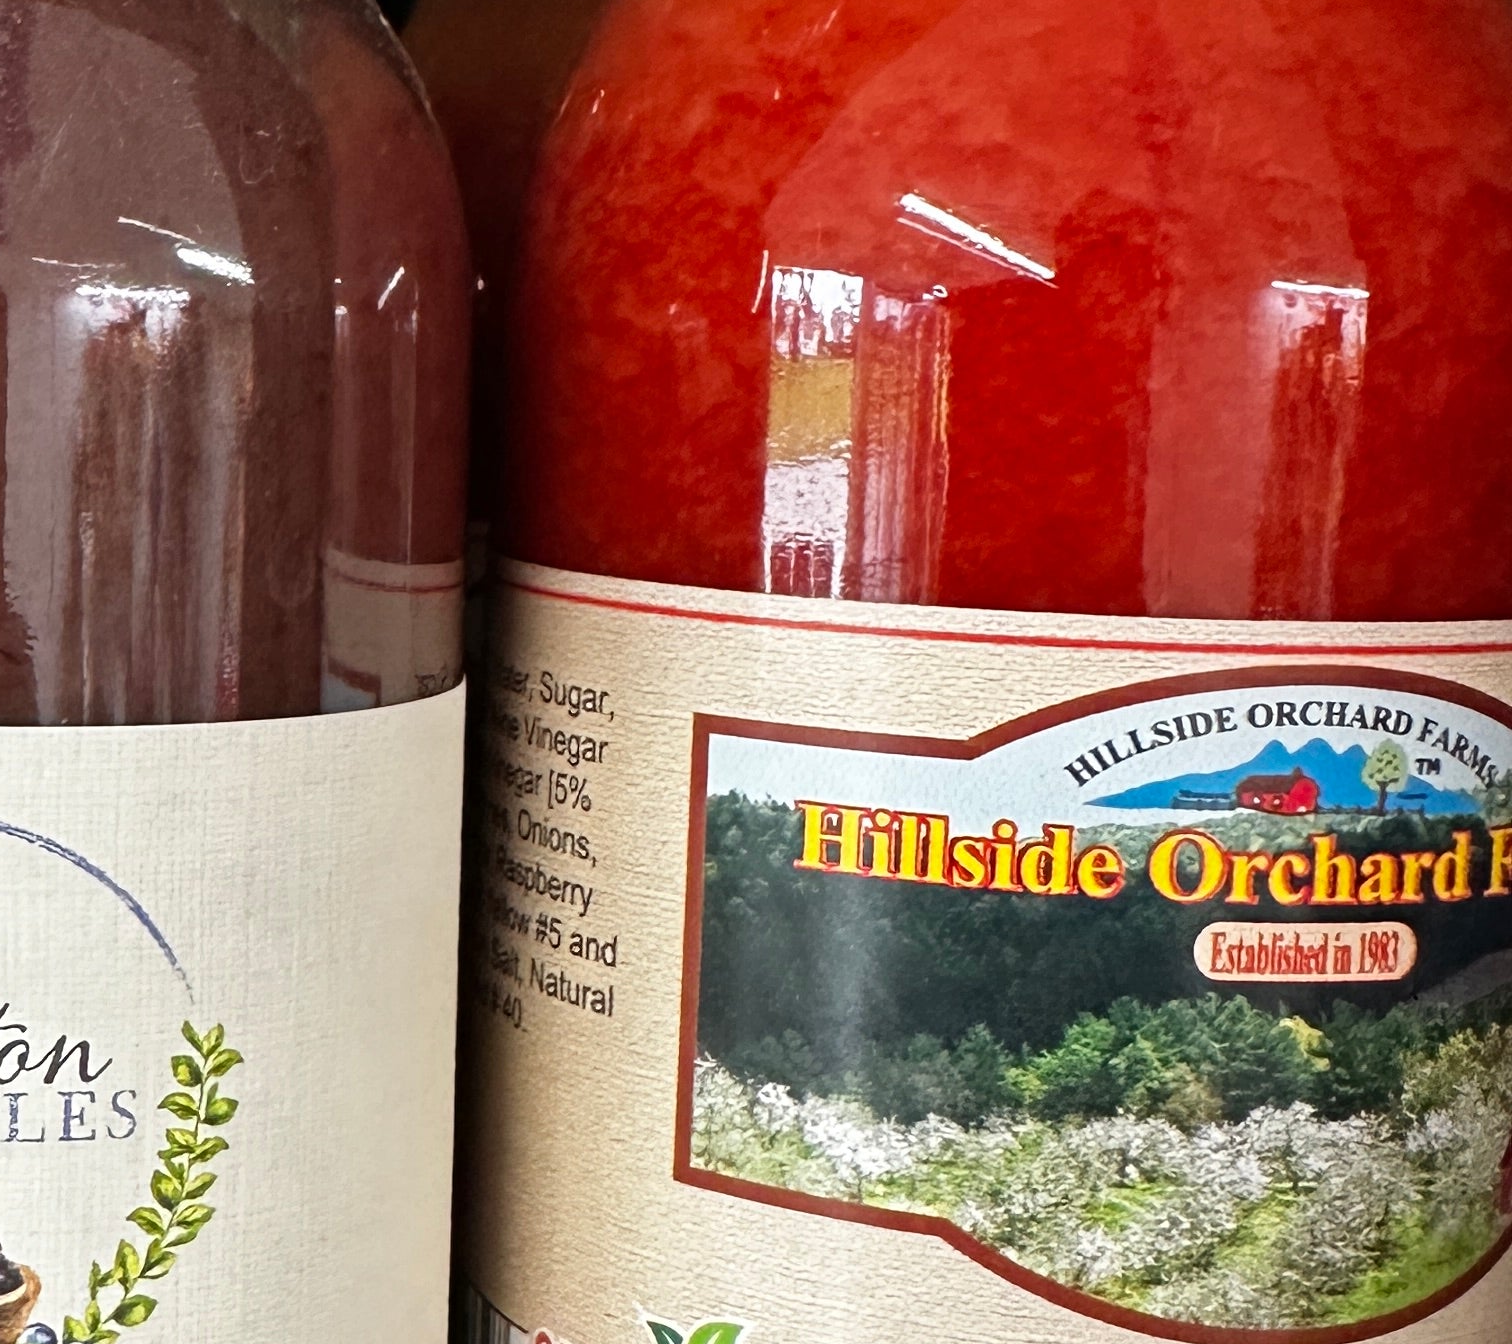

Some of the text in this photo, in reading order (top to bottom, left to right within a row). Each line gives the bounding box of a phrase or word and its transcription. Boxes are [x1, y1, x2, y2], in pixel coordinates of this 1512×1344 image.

[539, 671, 615, 722] Sugar,
[523, 712, 609, 767] Vinegar
[1063, 700, 1499, 789] HILLSIDE ORCHARD FARMS
[547, 768, 592, 814] [5%
[517, 809, 597, 868] Onions,
[792, 798, 1127, 901] Hillside
[1149, 825, 1476, 906] Orchard
[535, 913, 562, 951] #5
[569, 935, 619, 970] and
[1209, 929, 1400, 977] Established in 1983
[528, 959, 615, 1019] Natural
